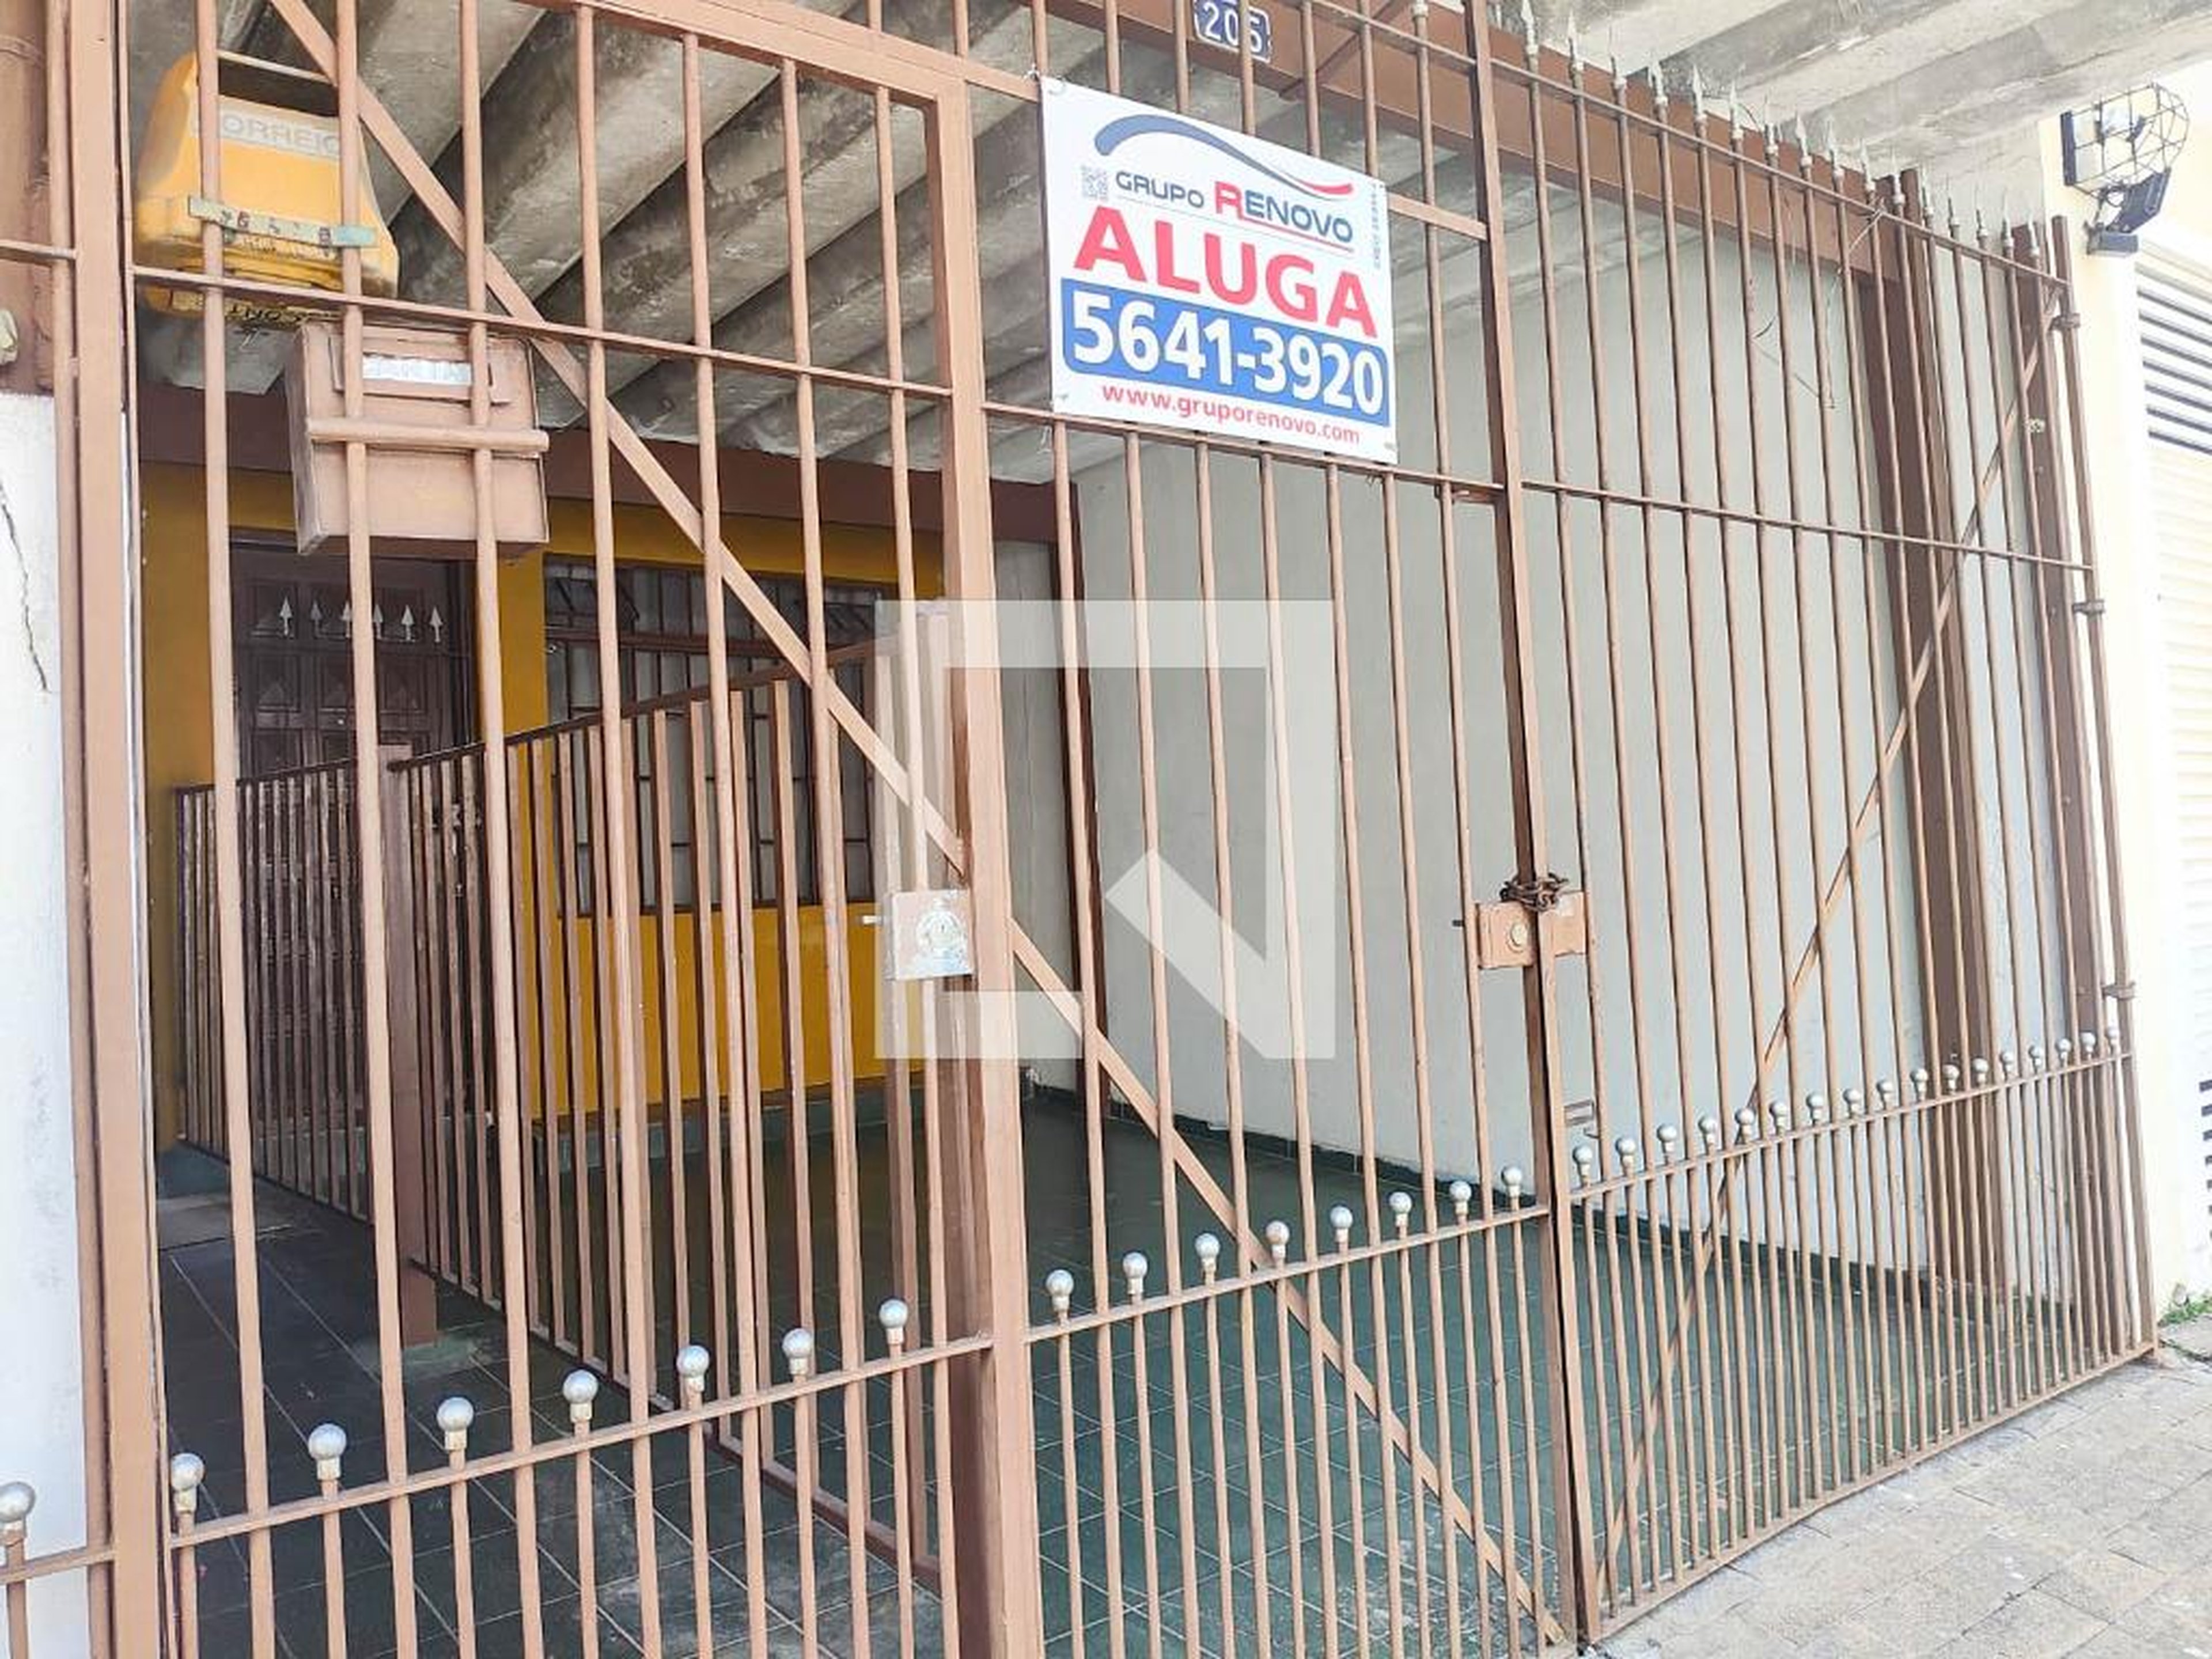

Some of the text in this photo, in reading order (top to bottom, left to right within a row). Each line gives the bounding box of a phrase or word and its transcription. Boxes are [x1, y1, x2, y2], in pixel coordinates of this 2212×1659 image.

[1116, 171, 1205, 208] GRUPO
[1215, 181, 1353, 243] RENOVO
[1074, 205, 1378, 338] ALUGA
[1073, 290, 1383, 415] 5641-3920
[1103, 385, 1360, 445] www.gruporenovo.com
